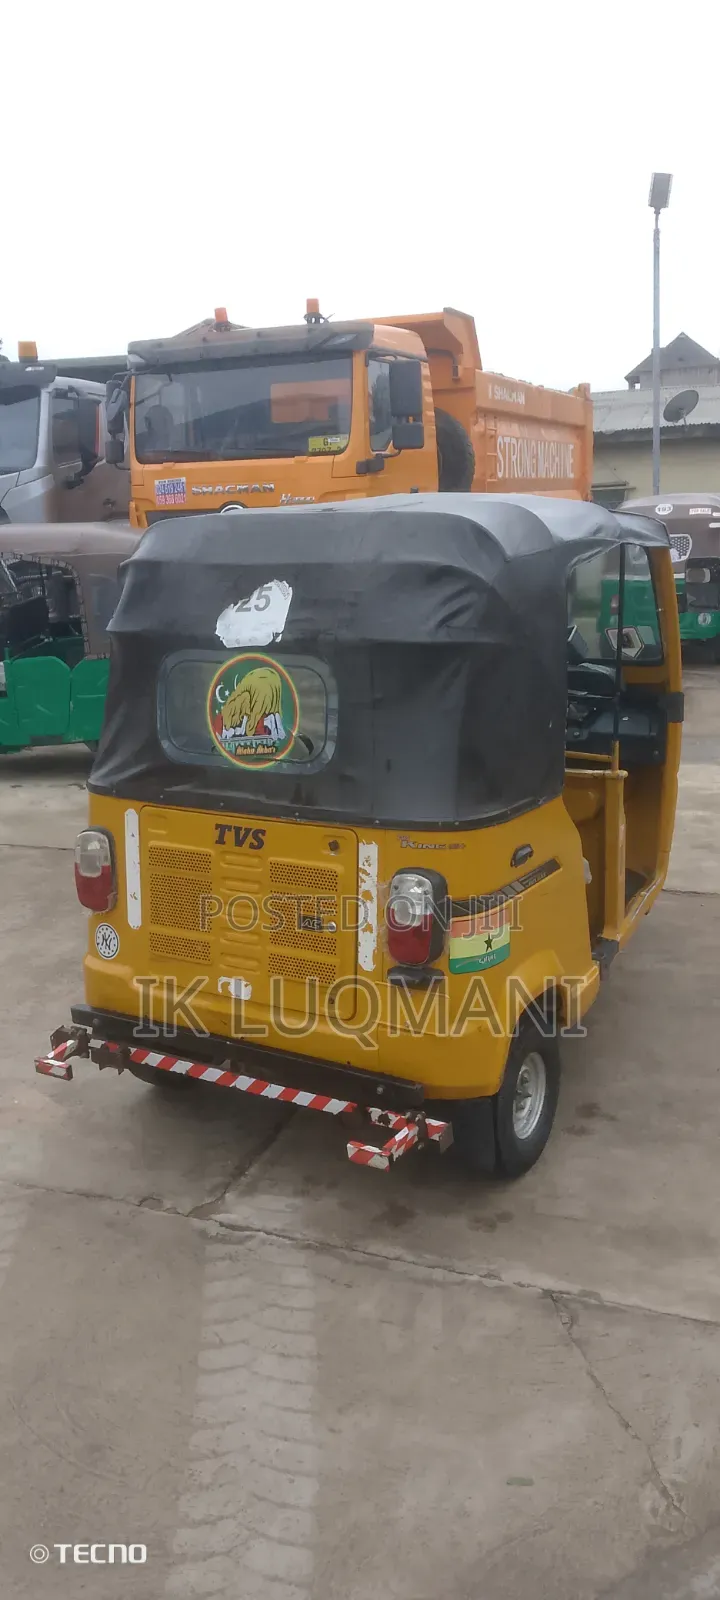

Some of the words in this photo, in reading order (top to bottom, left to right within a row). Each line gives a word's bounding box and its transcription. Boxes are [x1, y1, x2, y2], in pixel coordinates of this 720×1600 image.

[497, 436, 537, 478] STRONG
[538, 441, 575, 478] MACHINE
[191, 482, 275, 496] SHACMAN
[214, 823, 267, 850] TVS
